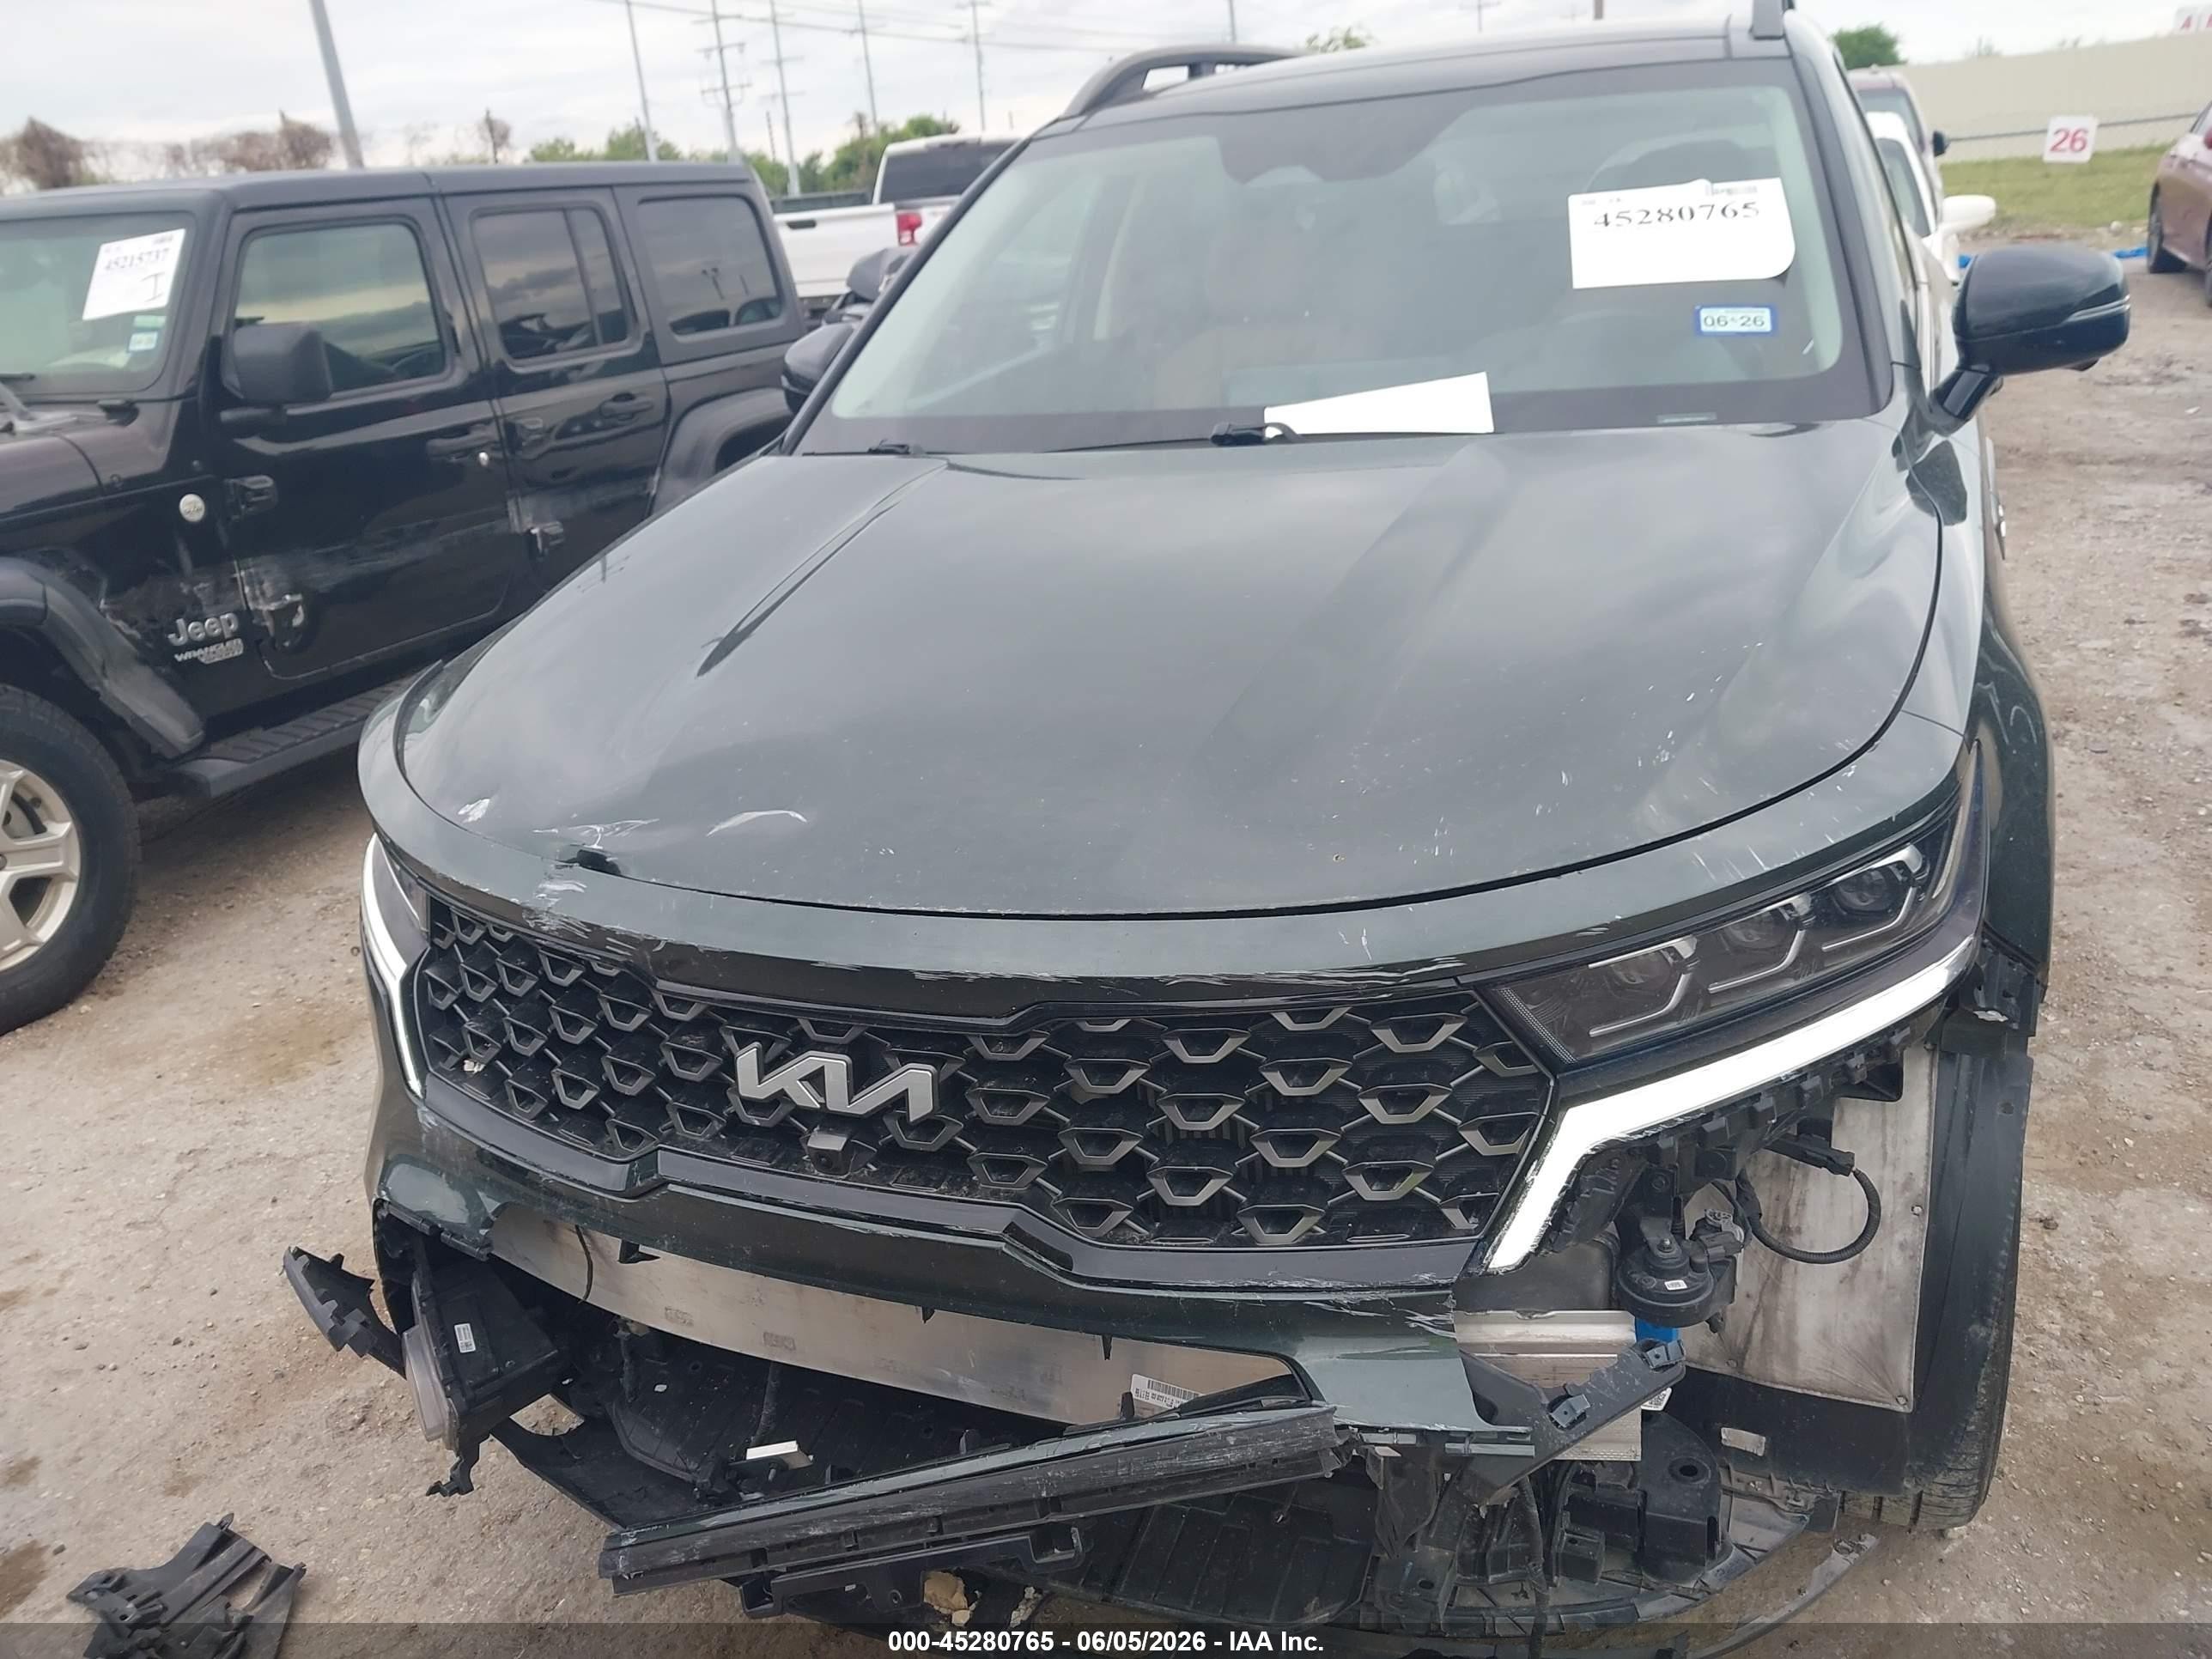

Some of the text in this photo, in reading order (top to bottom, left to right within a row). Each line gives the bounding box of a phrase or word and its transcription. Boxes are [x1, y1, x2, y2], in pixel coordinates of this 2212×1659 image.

[2050, 128, 2090, 153] 26
[1594, 202, 1760, 228] 45280765
[167, 612, 239, 646] Jeep
